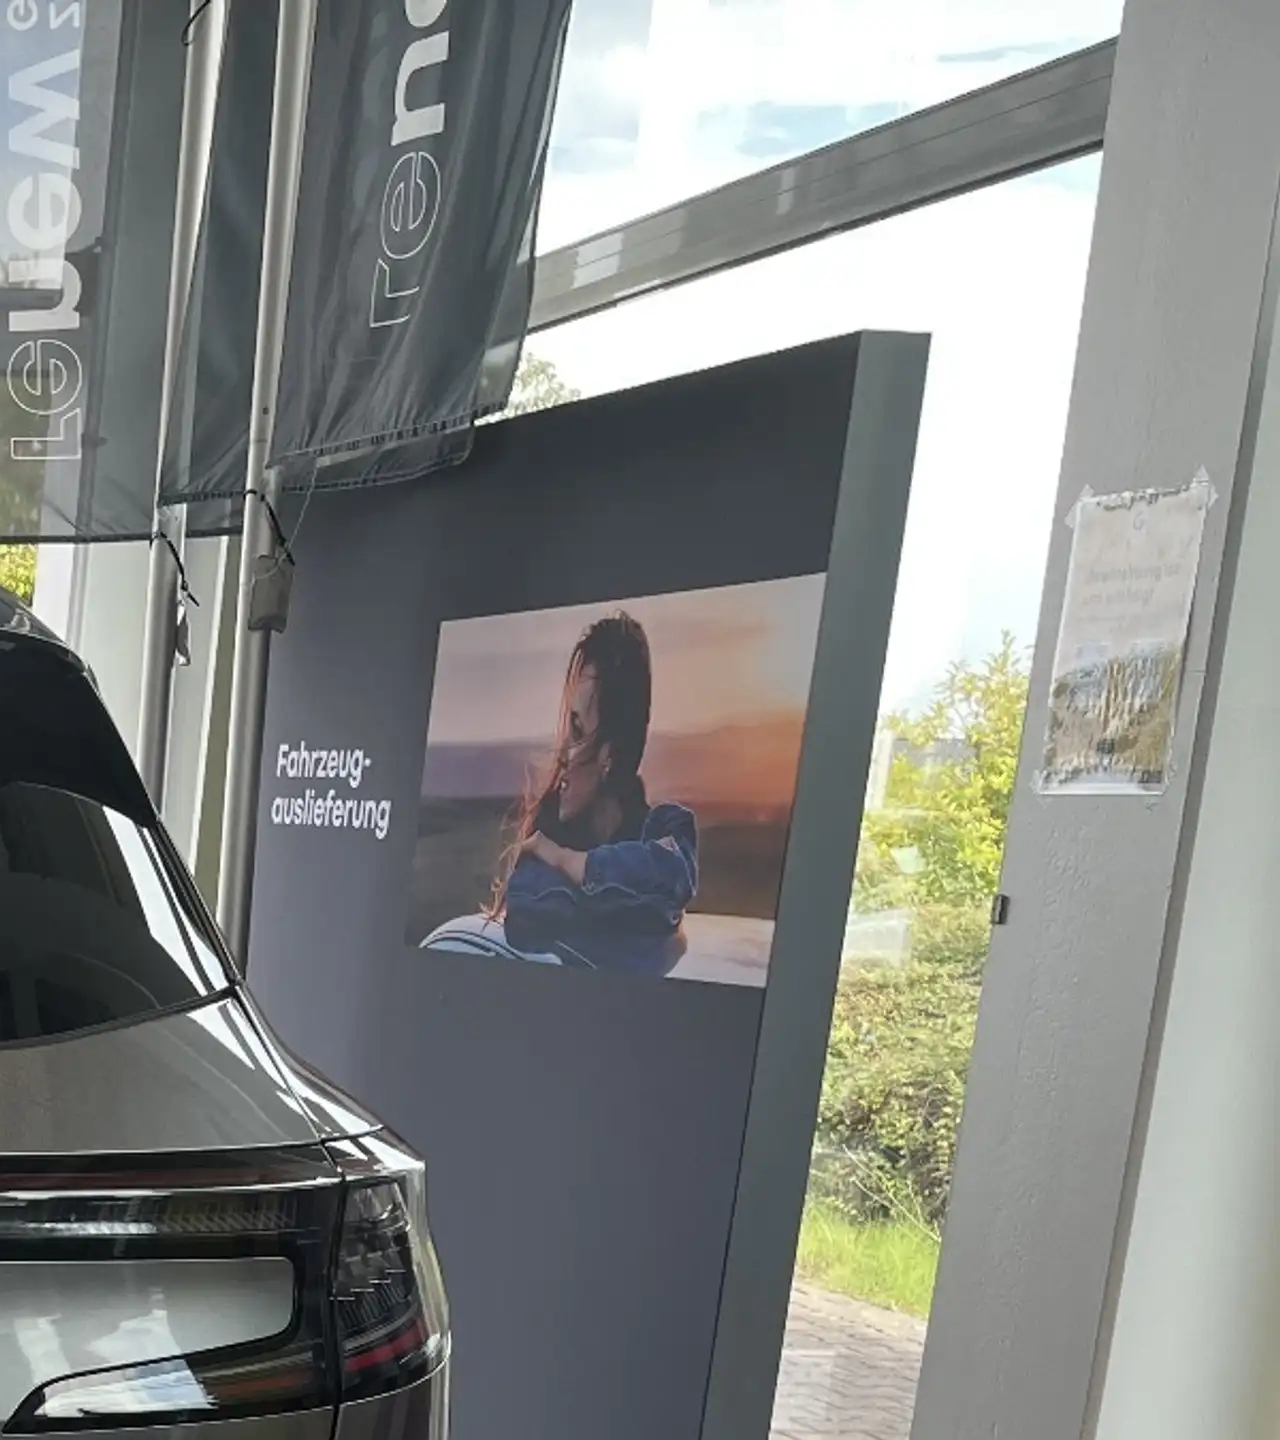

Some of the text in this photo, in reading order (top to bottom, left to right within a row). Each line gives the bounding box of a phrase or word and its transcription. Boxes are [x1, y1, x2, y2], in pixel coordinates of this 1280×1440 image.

[369, 0, 450, 328] ren
[276, 741, 372, 788] Fahrzeug-
[271, 789, 391, 839] auslieferung
